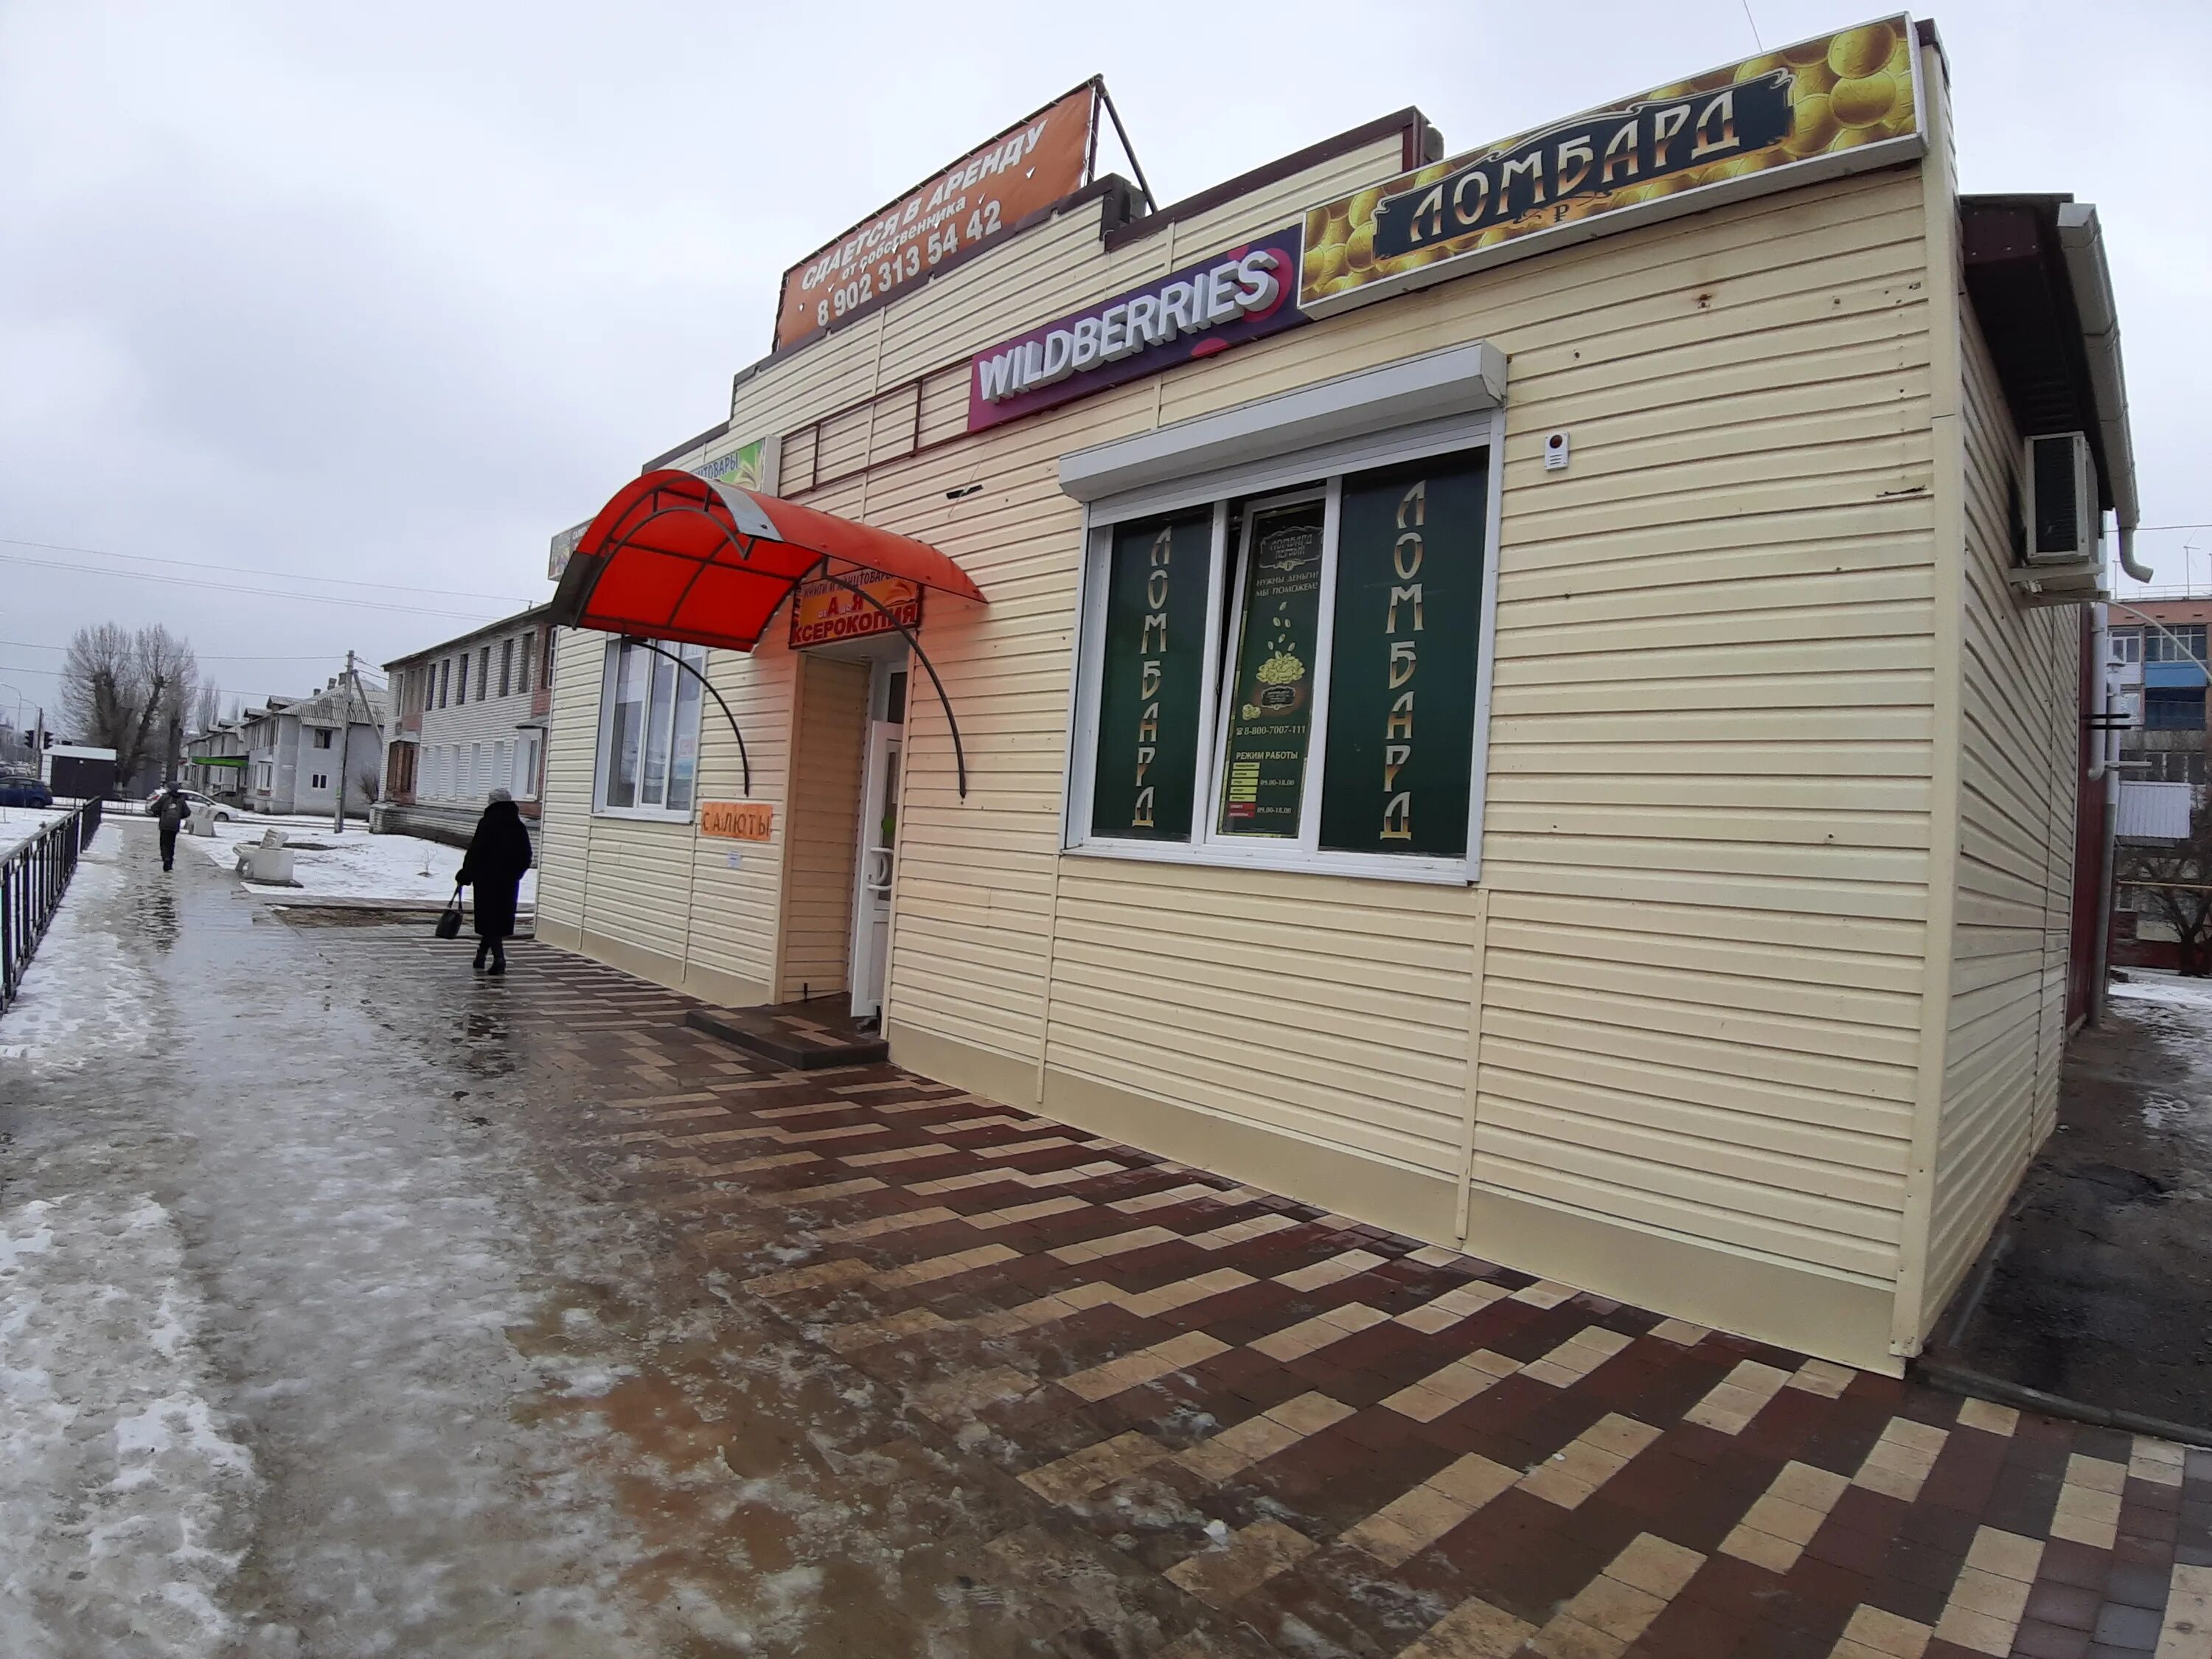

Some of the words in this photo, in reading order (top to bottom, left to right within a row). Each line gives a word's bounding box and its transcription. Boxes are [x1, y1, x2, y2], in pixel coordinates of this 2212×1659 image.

[801, 211, 900, 291] СДАЕТСЯ
[902, 197, 922, 226] В
[925, 118, 1048, 212] АРЕНДУ
[1410, 90, 1741, 243] ЛОМБАРД
[817, 299, 830, 327] 8
[833, 273, 873, 319] 902
[877, 246, 921, 293] 313
[927, 223, 959, 265] 54
[965, 199, 1003, 241] 42
[841, 260, 860, 281] от
[858, 195, 967, 270] собственника
[978, 250, 1281, 405] WILDBERRIES
[793, 604, 917, 644] КСЕРОКОПИЯ
[1131, 526, 1173, 828] ЛОМБАРД
[1380, 479, 1427, 841] ЛОМБАРД
[703, 812, 770, 836] САЛЮТЫ
[1236, 751, 1264, 760] РЕЖИМ
[1265, 751, 1298, 760] РАБОТЫ
